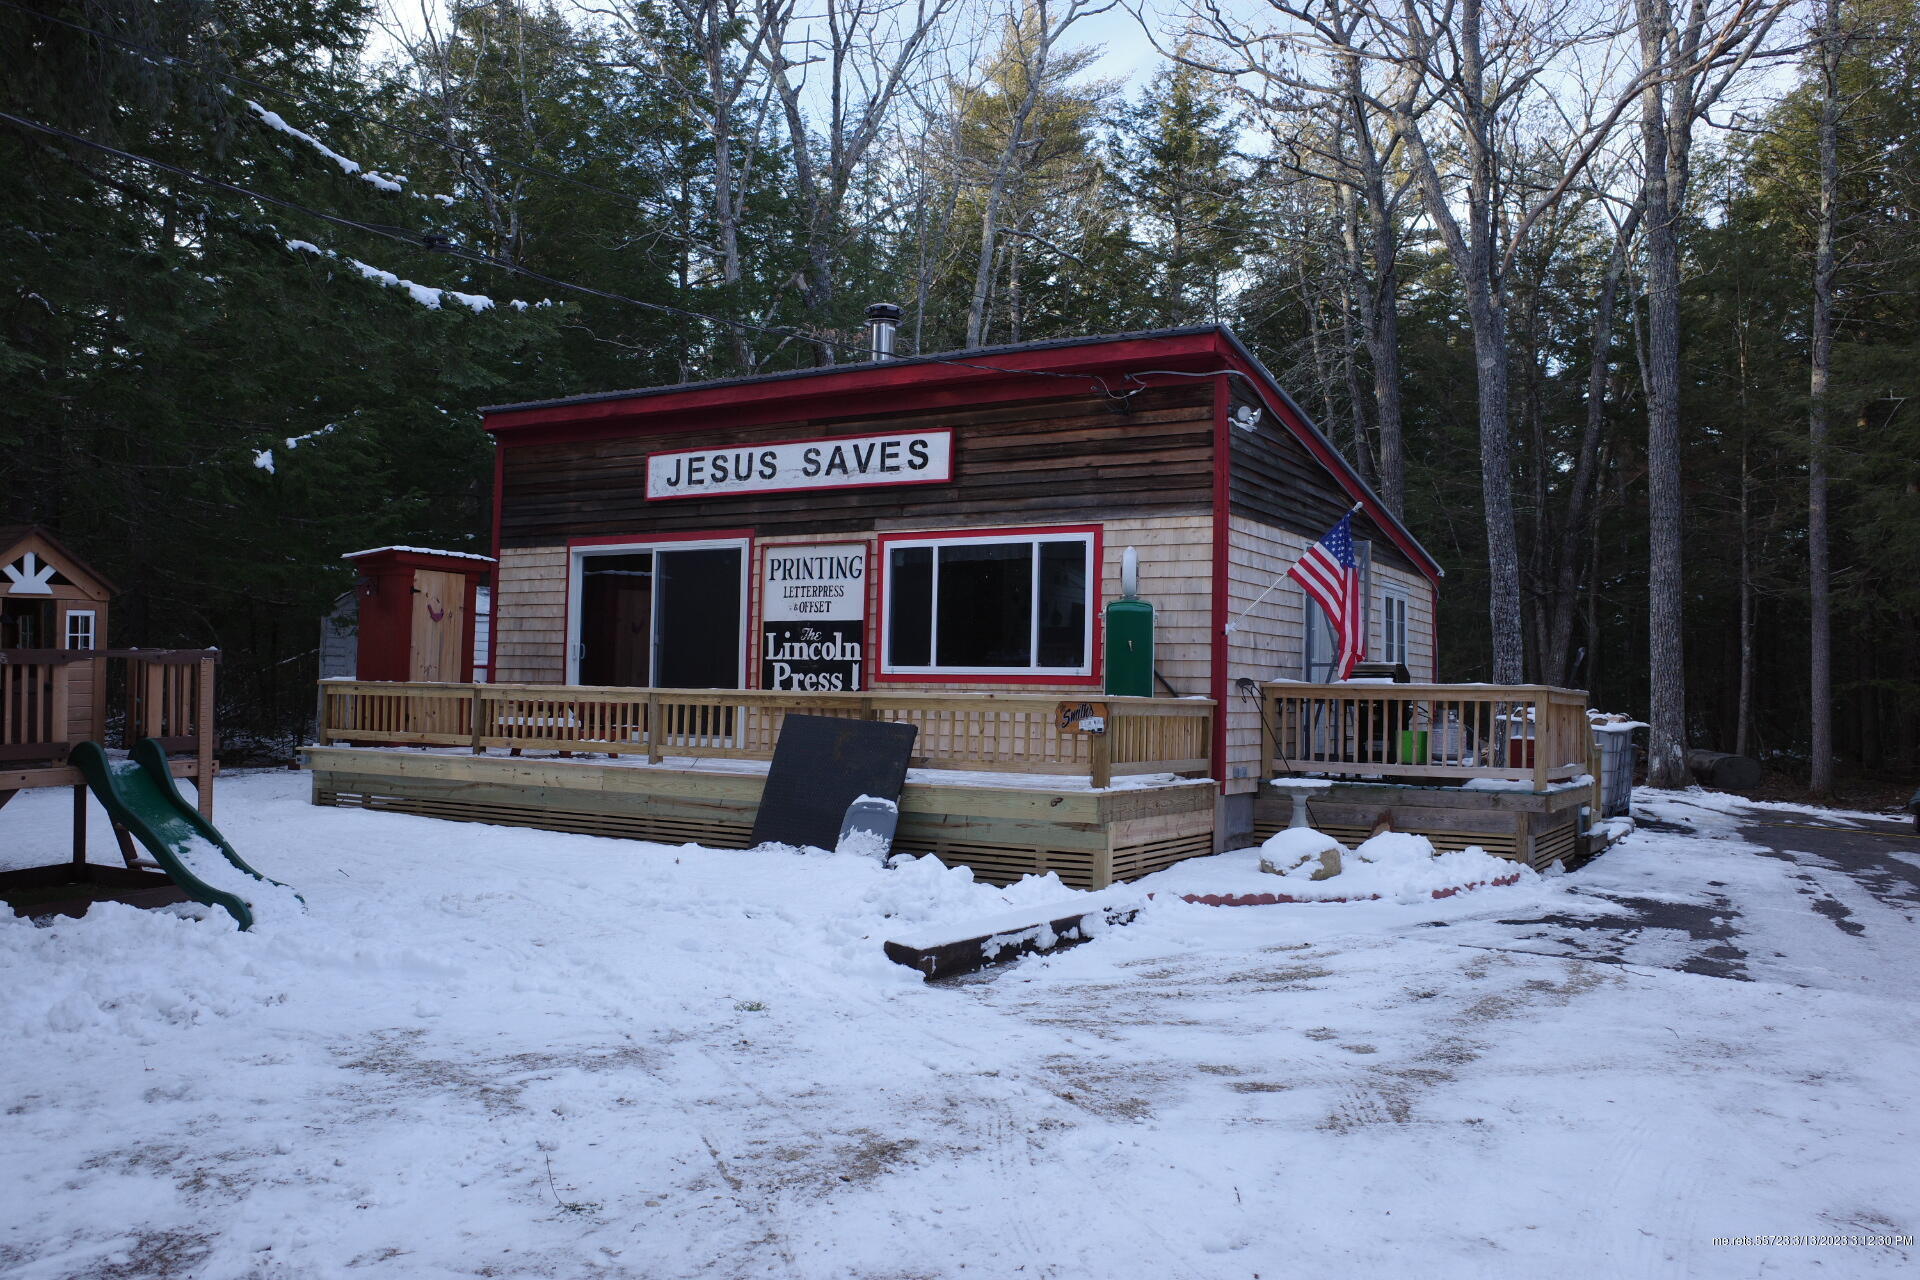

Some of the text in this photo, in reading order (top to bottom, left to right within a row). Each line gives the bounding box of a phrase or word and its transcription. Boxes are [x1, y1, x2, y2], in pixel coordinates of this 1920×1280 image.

[666, 439, 929, 487] JESUS SAVES
[769, 556, 862, 580] PRINTING
[783, 585, 844, 598] LETTERPRESS
[799, 601, 832, 613] OFFSET
[765, 631, 862, 660] Lincoln
[801, 627, 822, 640] The
[772, 662, 843, 691] Press
